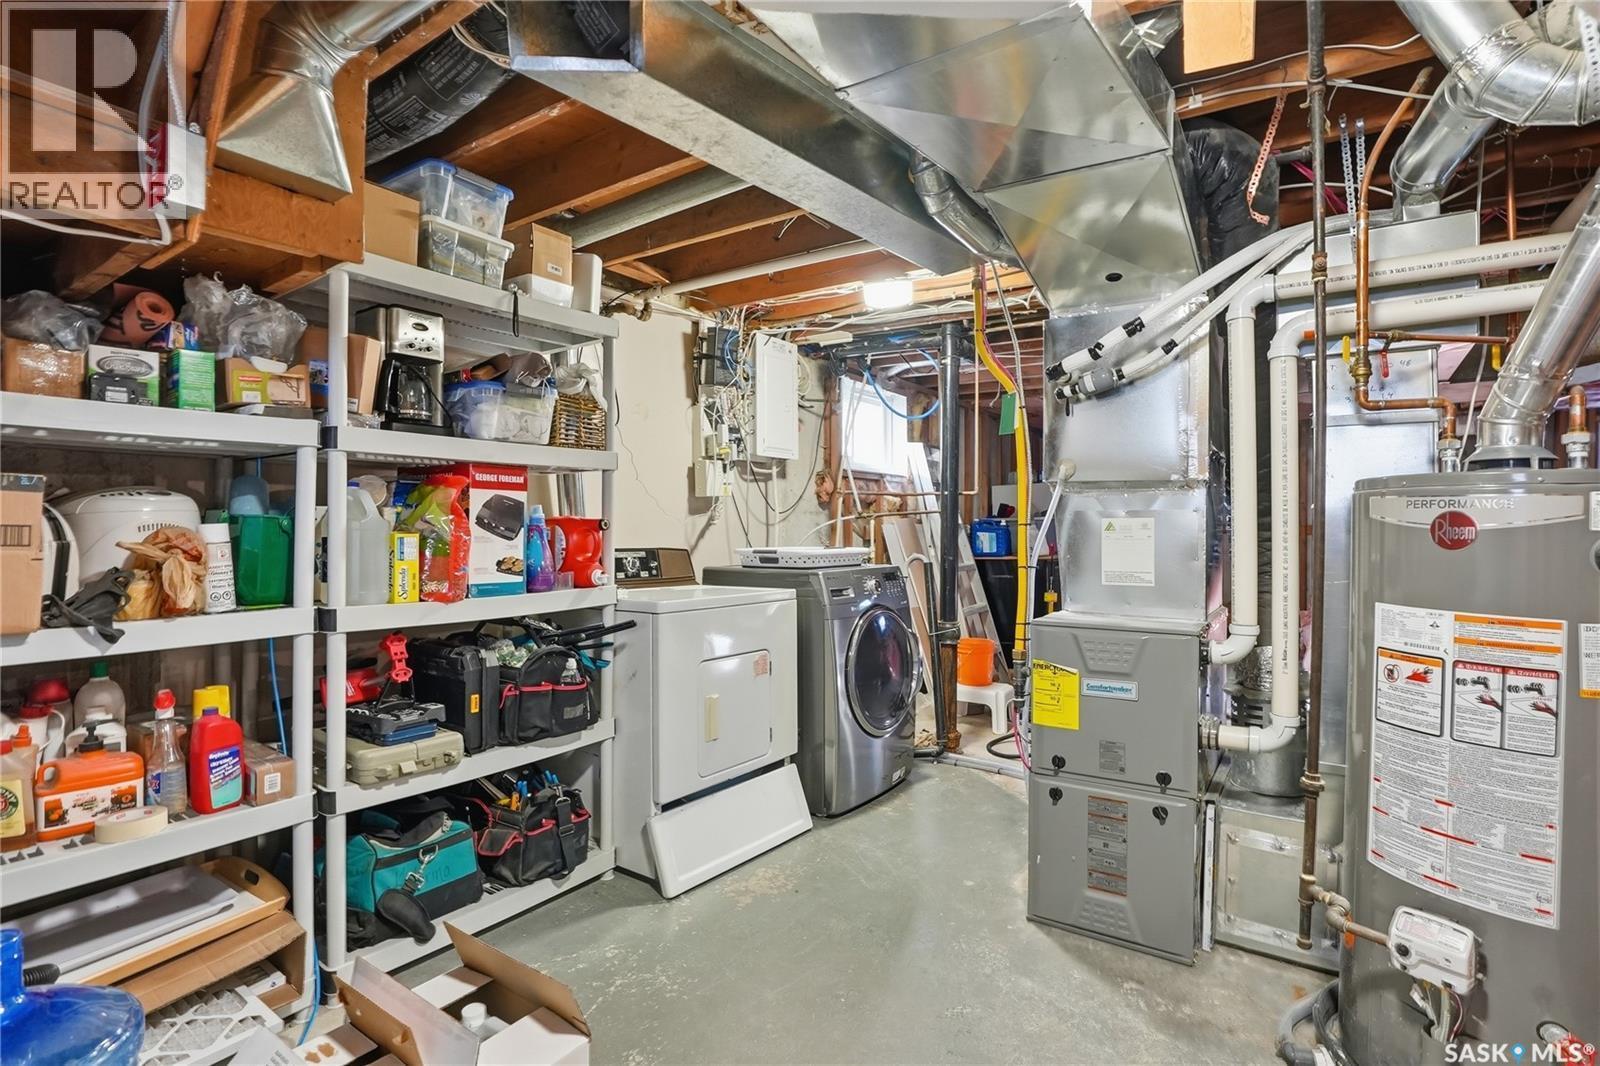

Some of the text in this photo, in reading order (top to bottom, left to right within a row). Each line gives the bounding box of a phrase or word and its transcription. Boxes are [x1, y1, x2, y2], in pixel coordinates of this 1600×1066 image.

[475, 473, 524, 483] GEORGE FOREMAN
[1406, 498, 1514, 509] PERFORMANCE
[1435, 512, 1476, 545] Rheem
